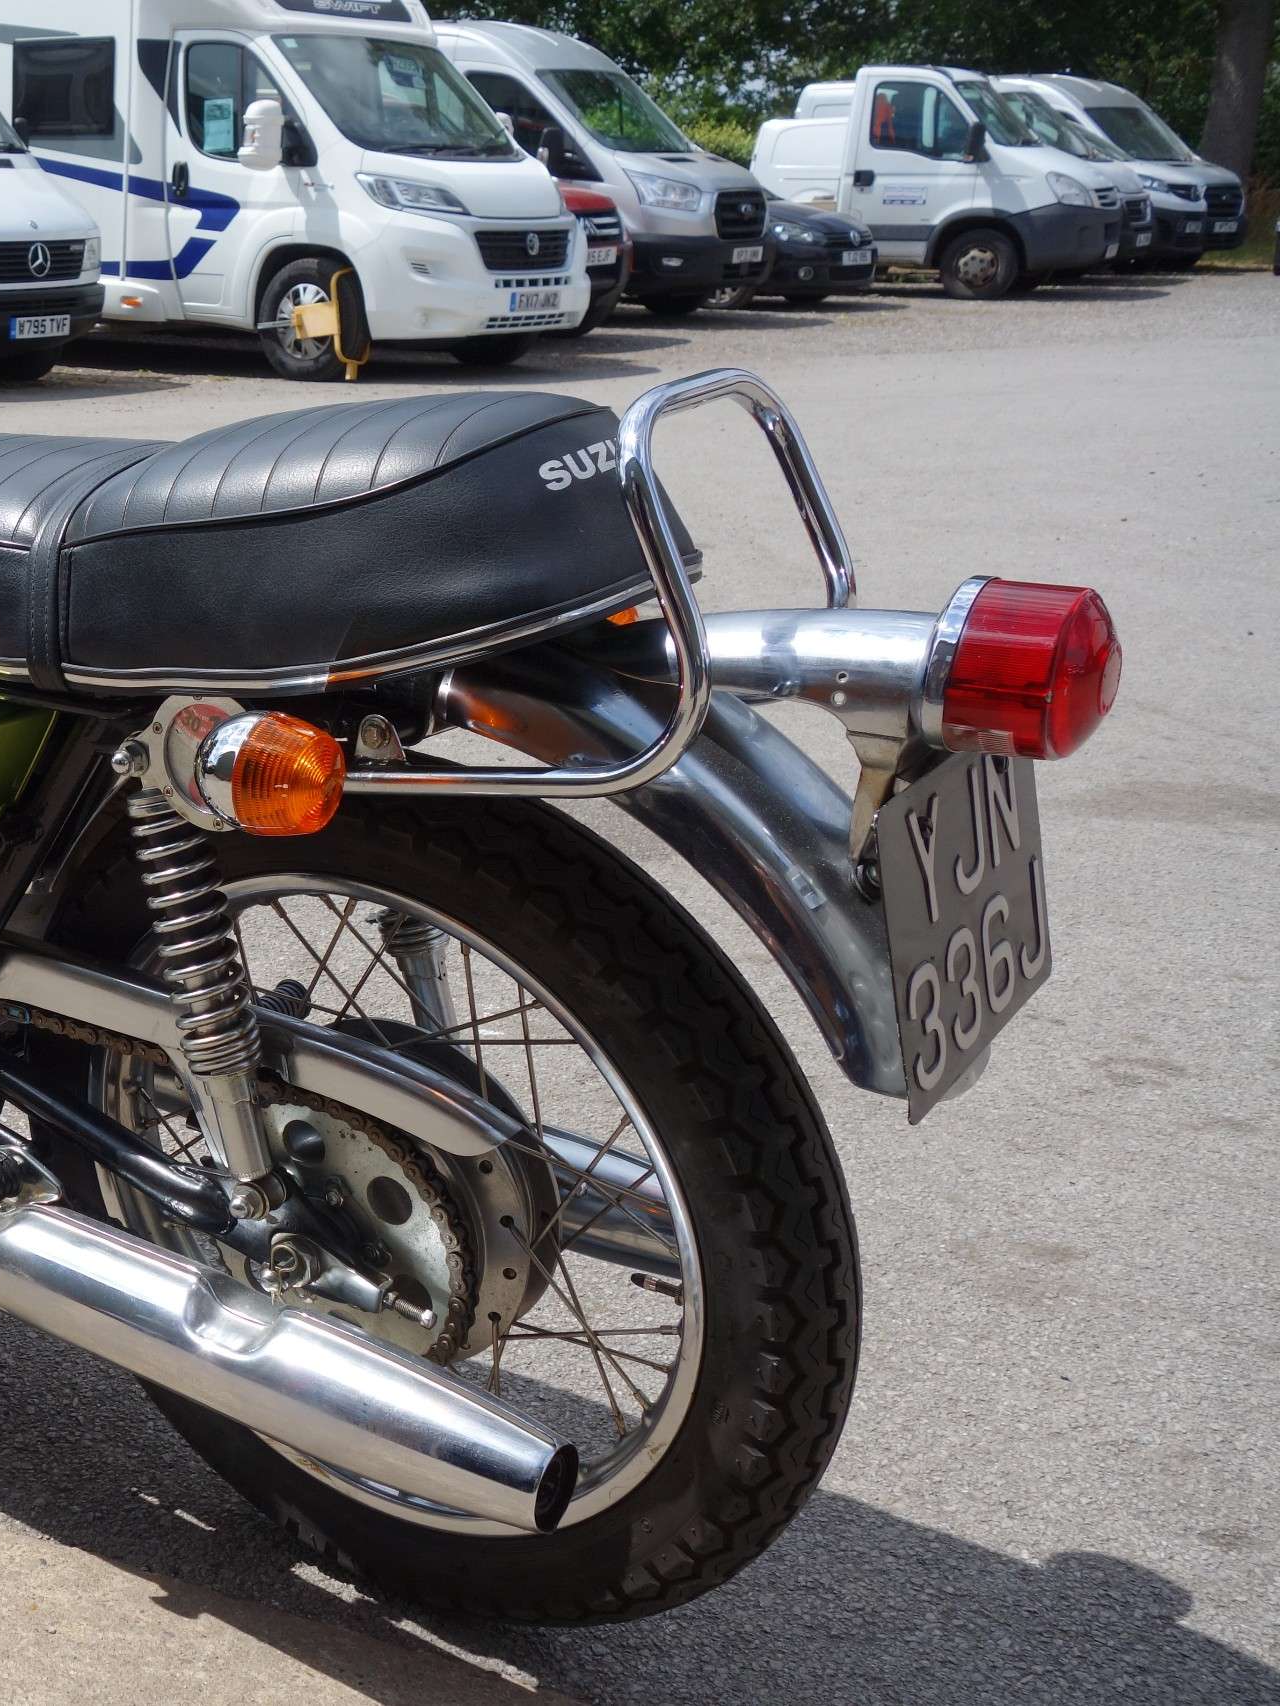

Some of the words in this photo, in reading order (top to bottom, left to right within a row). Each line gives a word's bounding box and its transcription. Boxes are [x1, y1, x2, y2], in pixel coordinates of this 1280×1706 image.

[313, 0, 380, 14] SWIFT
[49, 317, 68, 333] TVF
[905, 753, 1021, 924] YJN
[907, 854, 1048, 1092] 336J
